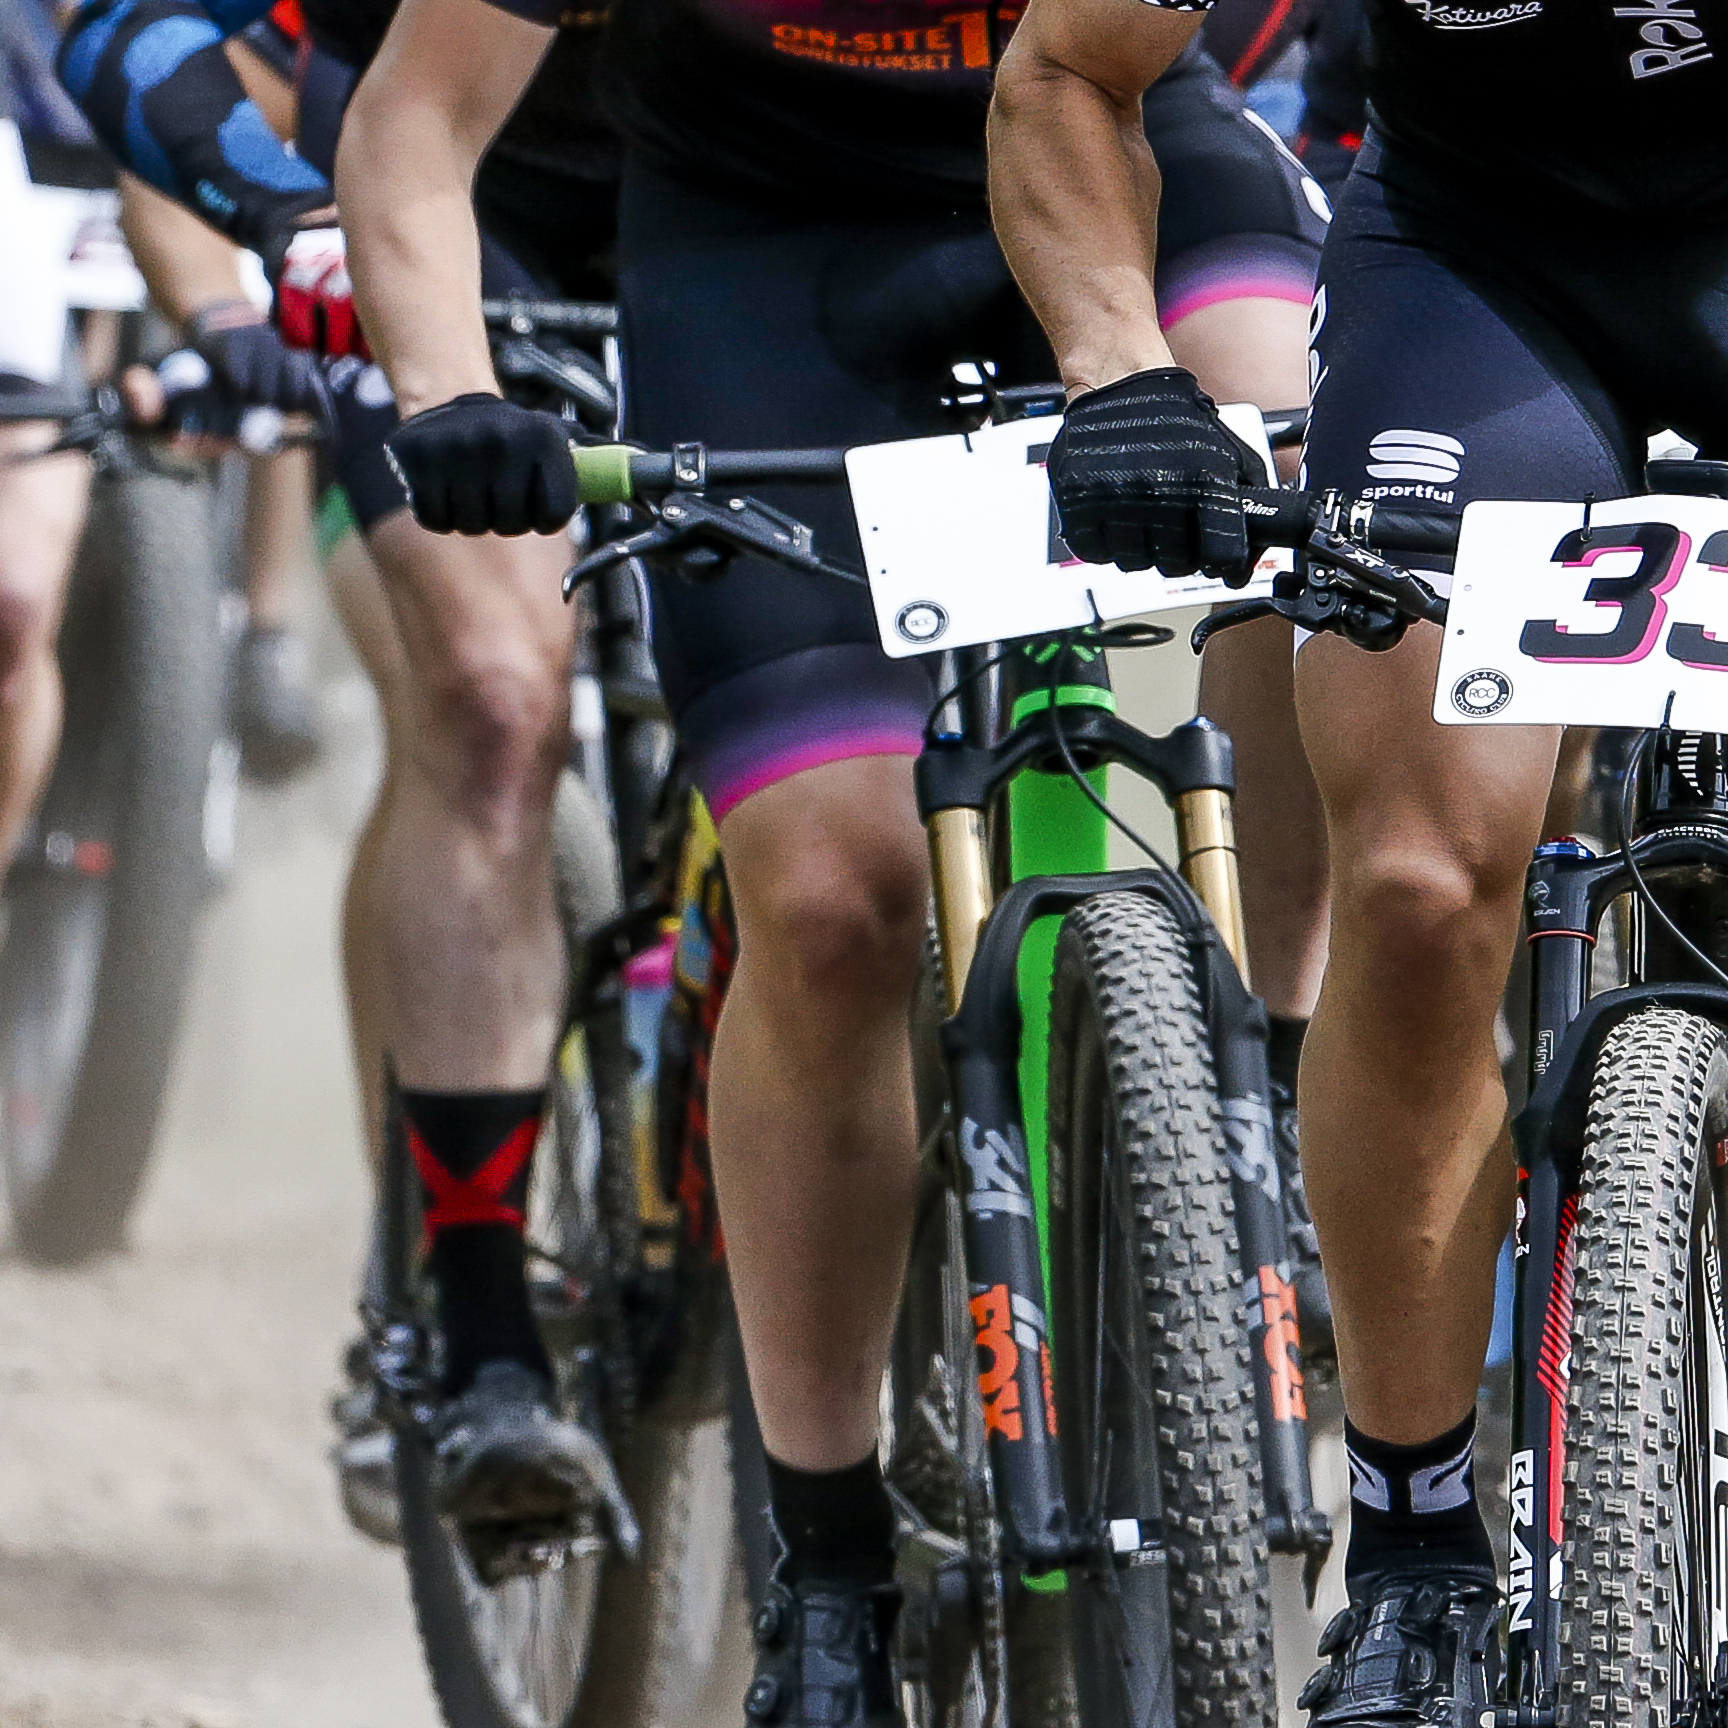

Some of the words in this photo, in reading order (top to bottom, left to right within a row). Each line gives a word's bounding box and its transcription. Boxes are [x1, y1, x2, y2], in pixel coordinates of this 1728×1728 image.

[1361, 484, 1454, 504] sportful
[1344, 549, 1386, 569] XT
[1469, 687, 1496, 699] RCC
[1509, 1449, 1535, 1633] BRAIN
